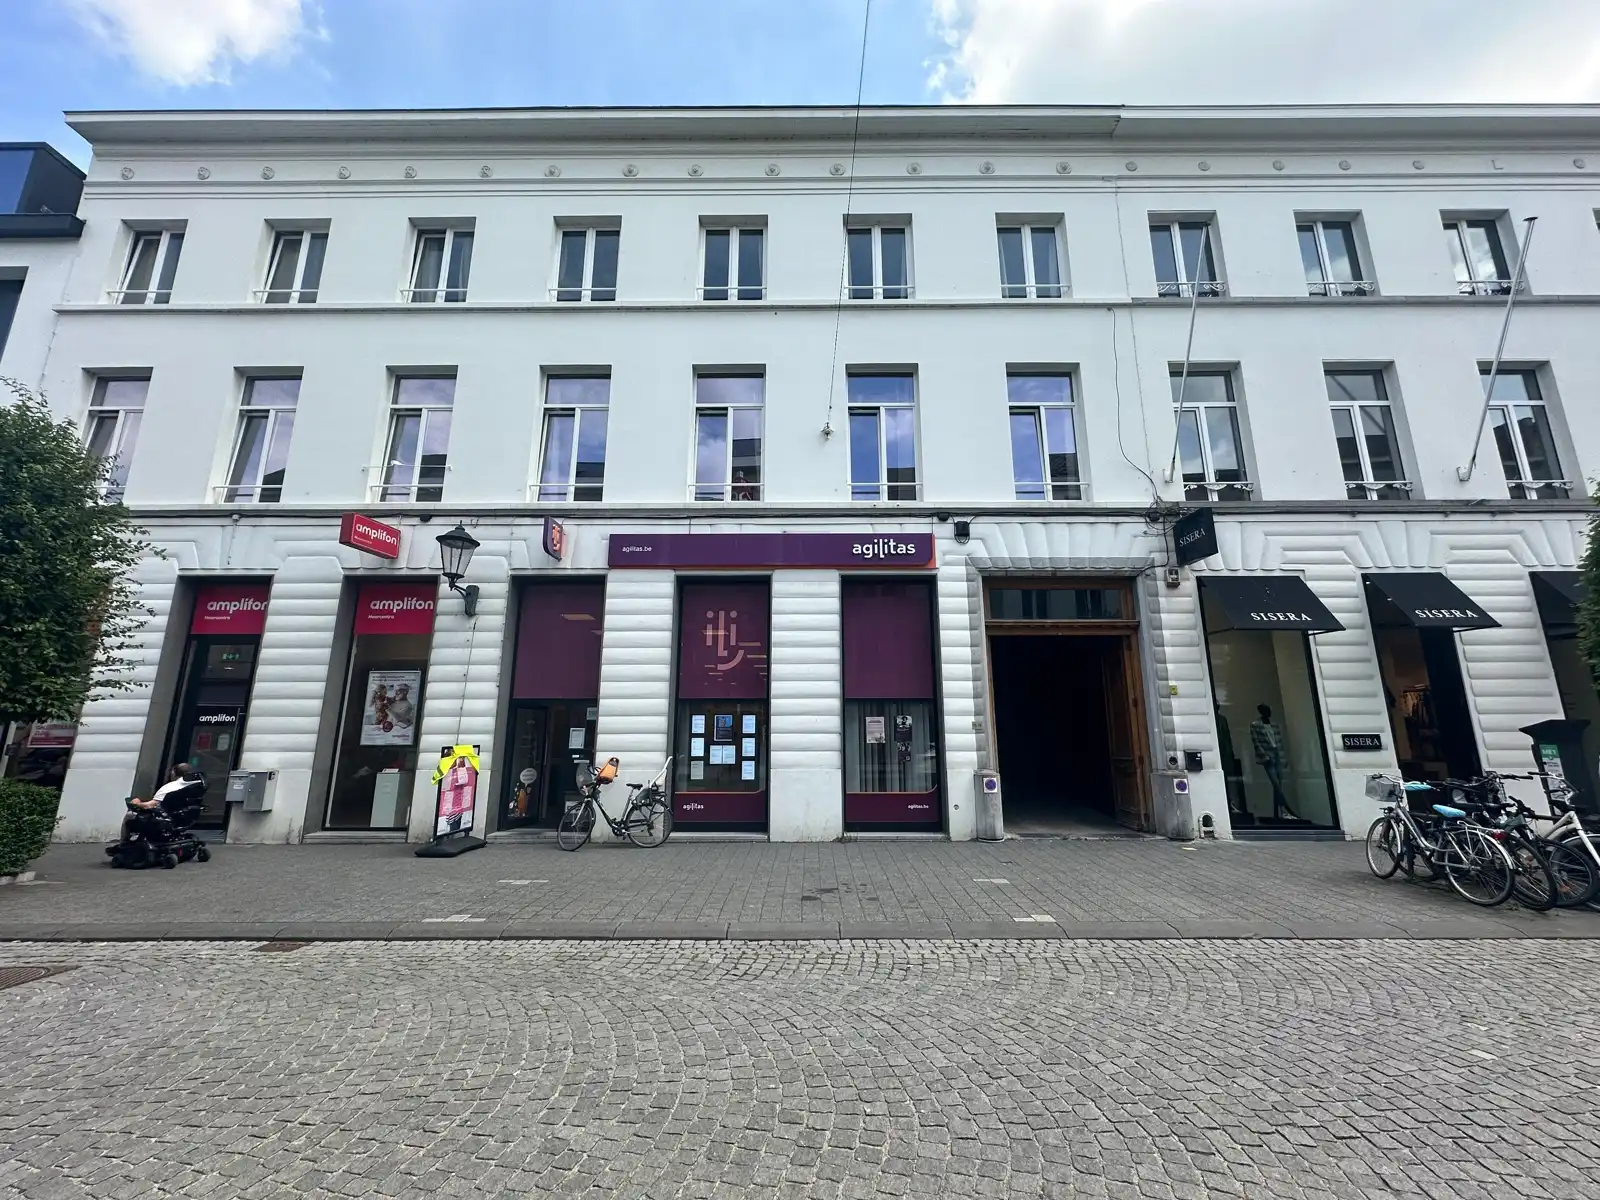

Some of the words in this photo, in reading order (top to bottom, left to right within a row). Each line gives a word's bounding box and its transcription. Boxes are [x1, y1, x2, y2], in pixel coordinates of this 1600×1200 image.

[355, 524, 397, 546] amplifon
[1180, 528, 1205, 547] SISERA
[852, 538, 916, 559] agilitas
[370, 597, 434, 613] amplifon
[1250, 612, 1313, 621] SISERA
[1415, 609, 1480, 618] SISERA
[199, 713, 236, 724] amplifon
[1344, 737, 1380, 746] SISERA
